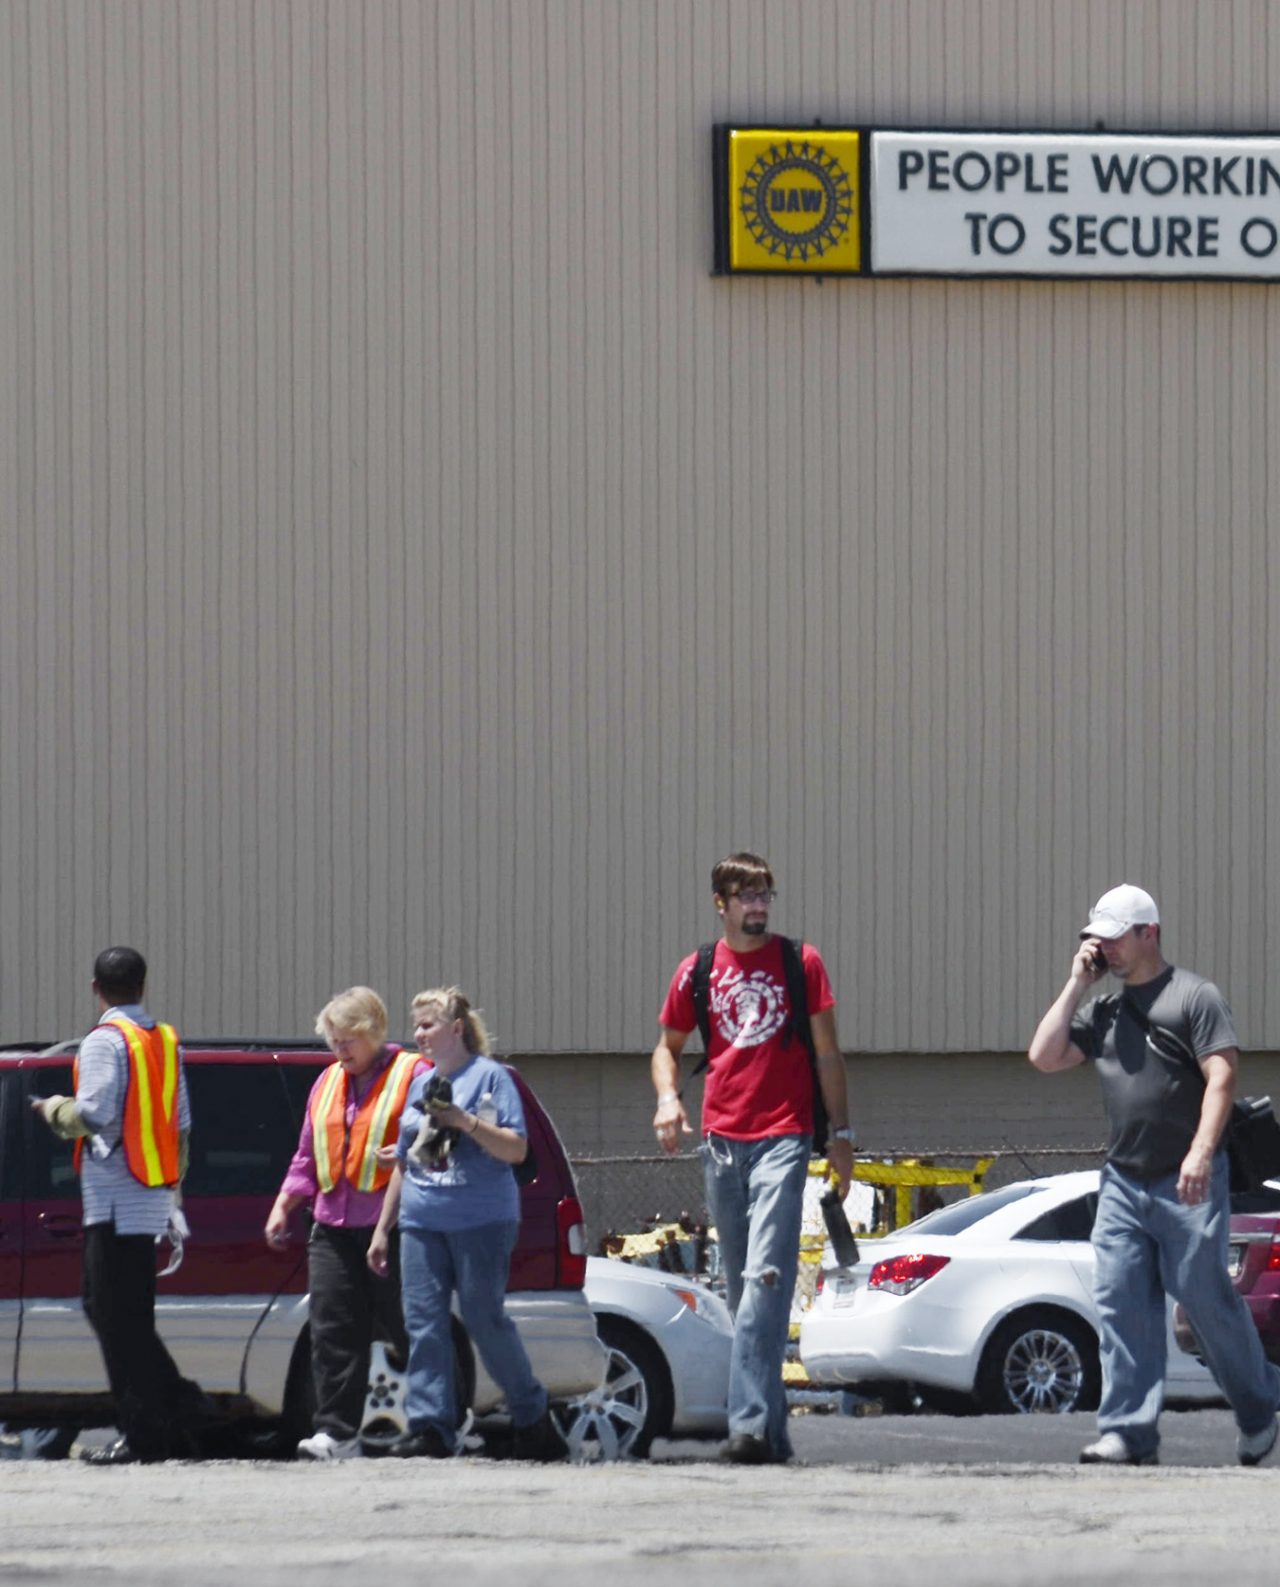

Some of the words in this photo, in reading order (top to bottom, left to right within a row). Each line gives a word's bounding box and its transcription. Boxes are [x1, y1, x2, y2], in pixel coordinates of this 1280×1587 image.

[898, 150, 1069, 194] PEOPLE
[770, 188, 822, 212] UAW
[964, 212, 1026, 256] TO
[1048, 213, 1219, 258] SECURE
